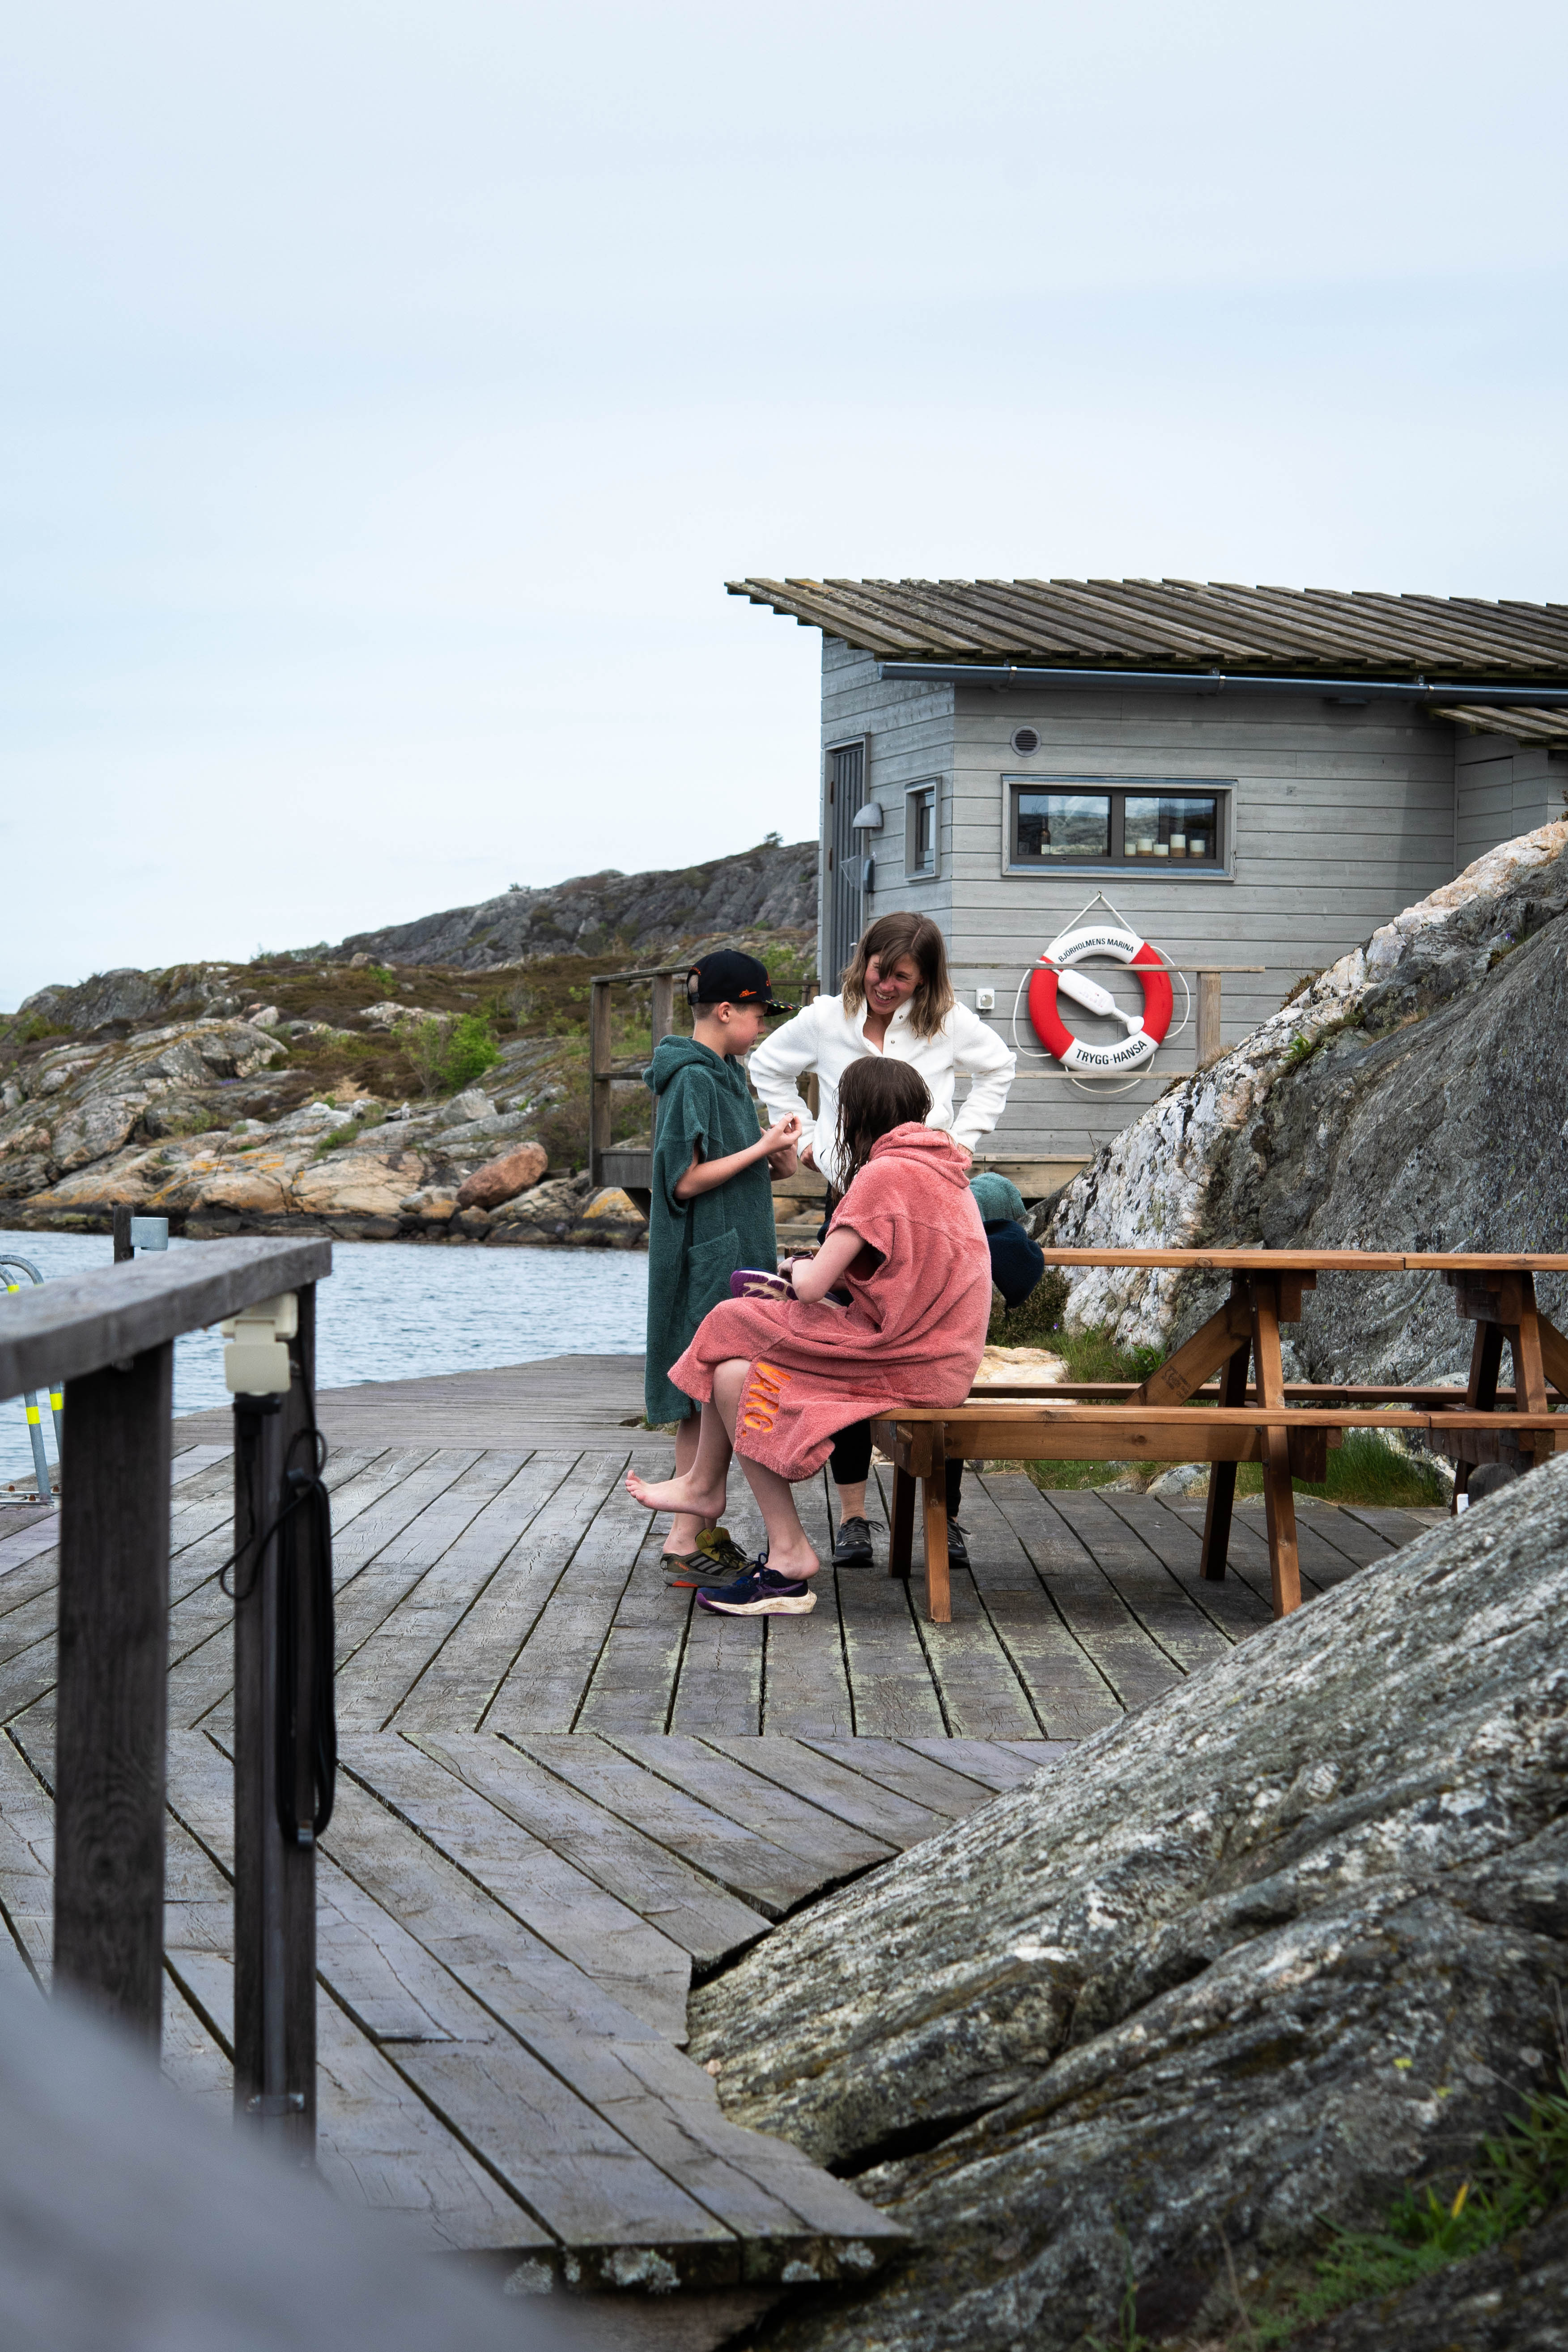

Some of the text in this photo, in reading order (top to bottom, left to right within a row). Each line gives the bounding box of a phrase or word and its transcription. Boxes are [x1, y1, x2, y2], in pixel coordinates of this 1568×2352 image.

[1058, 938, 1134, 962] BJÖRHOLMENS MARINA
[1076, 1040, 1147, 1065] TRYGG-HANSA
